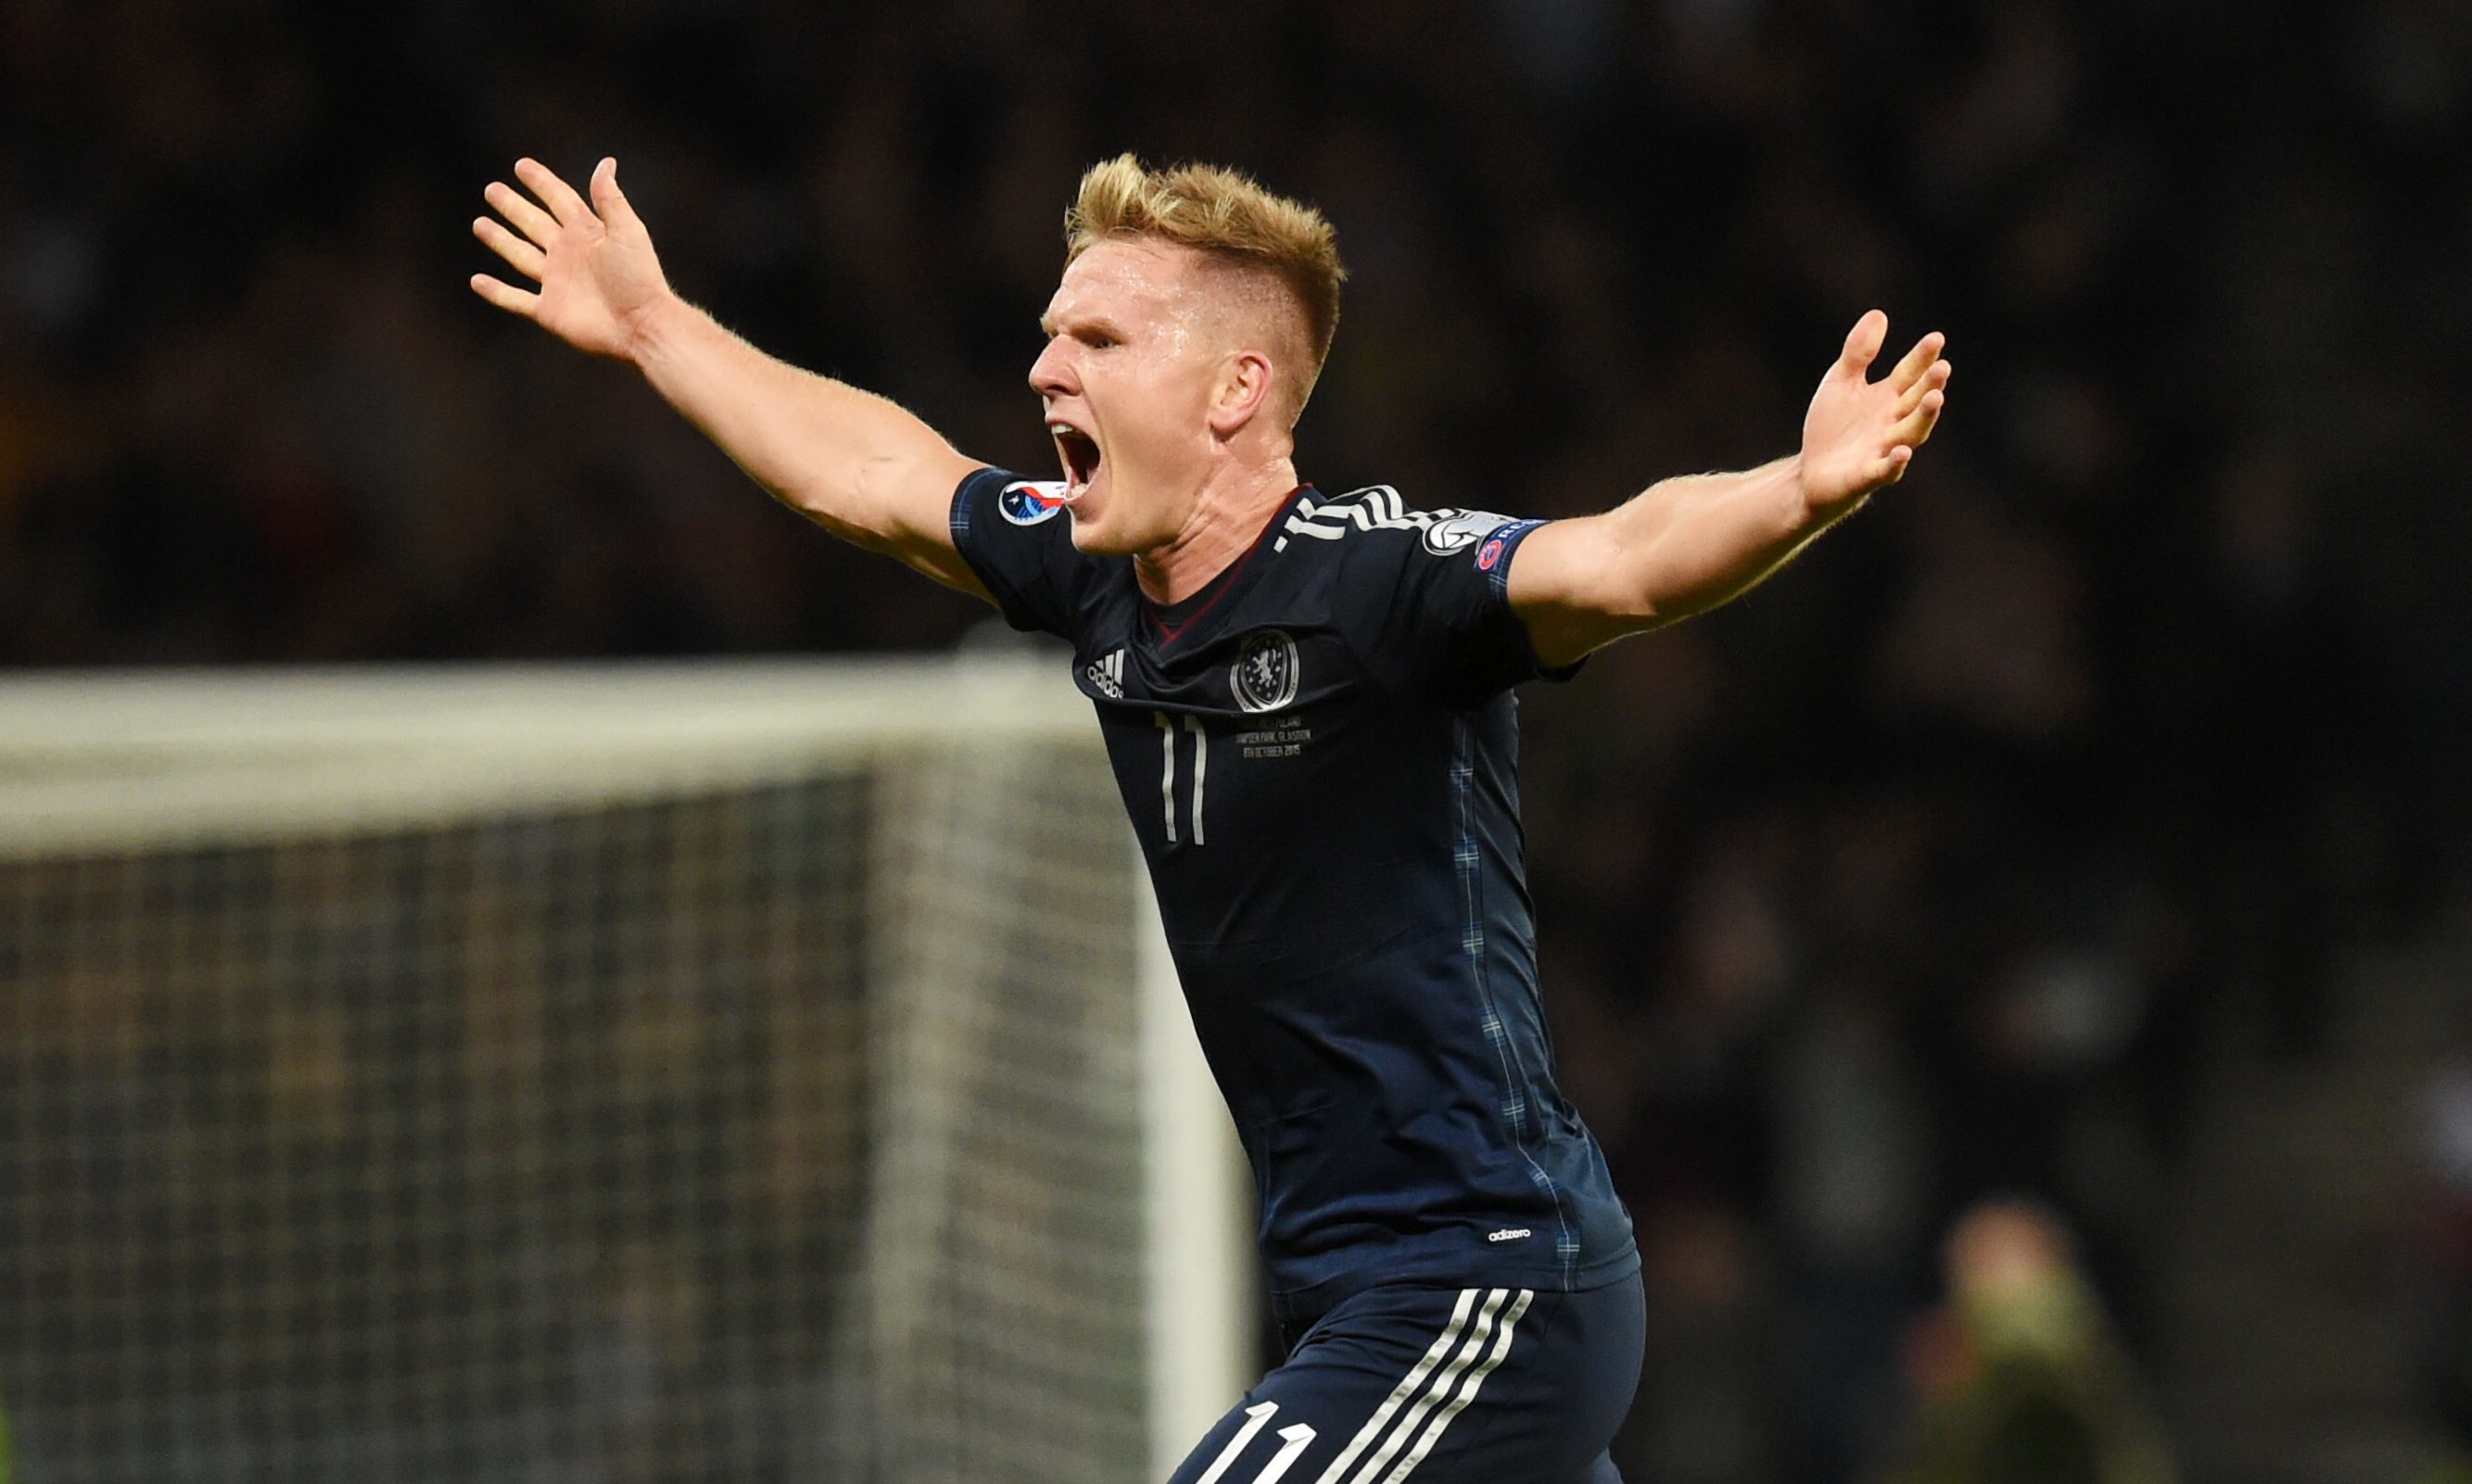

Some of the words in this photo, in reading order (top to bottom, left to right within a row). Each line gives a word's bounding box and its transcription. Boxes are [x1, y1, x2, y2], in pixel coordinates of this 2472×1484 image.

[1086, 666, 1124, 699] adidas
[1154, 711, 1207, 845] 11
[1489, 1229, 1531, 1242] adizero
[1195, 1401, 1318, 1484] 11
